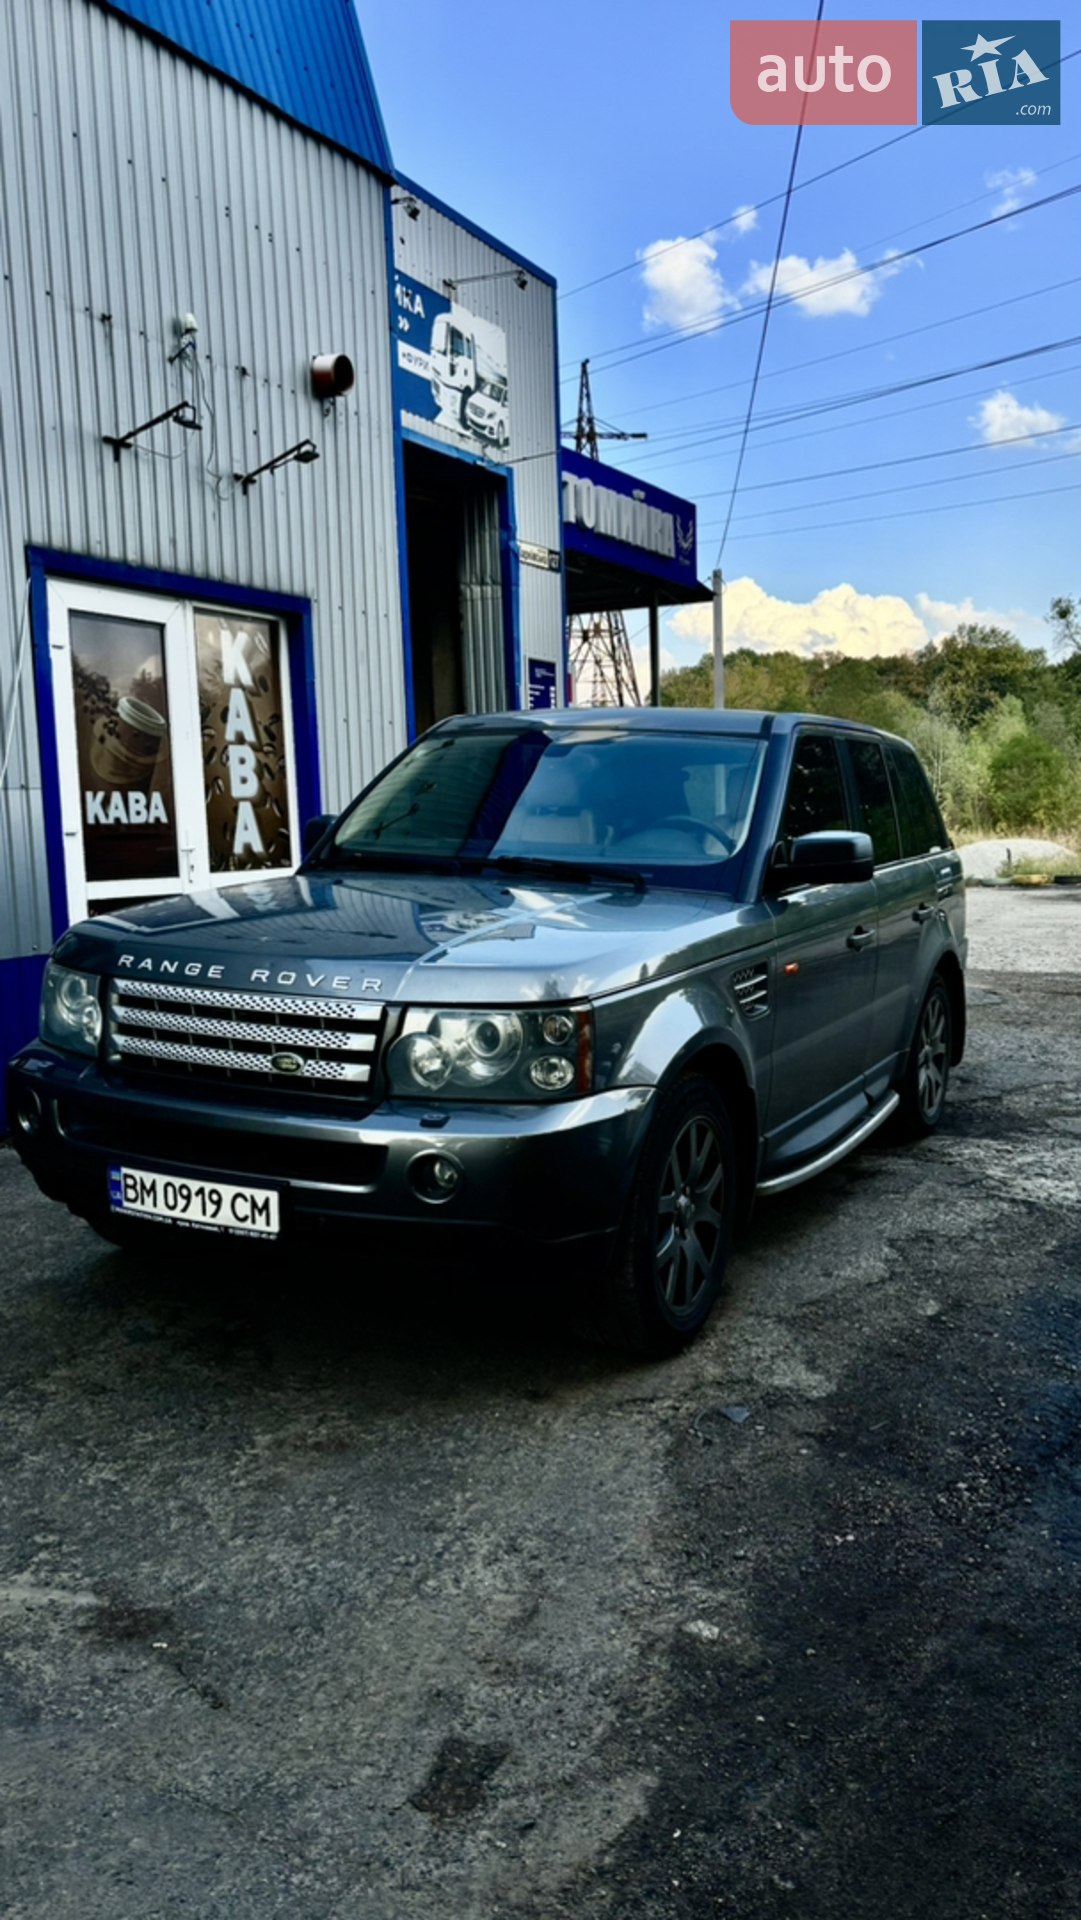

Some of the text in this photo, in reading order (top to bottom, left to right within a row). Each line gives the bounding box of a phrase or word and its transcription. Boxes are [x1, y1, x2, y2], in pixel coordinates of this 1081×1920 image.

[220, 628, 266, 855] КАВА
[84, 790, 168, 825] КАВА
[117, 954, 383, 992] RANGE ROVER
[123, 1173, 158, 1208] BM
[163, 1181, 223, 1219] 0919
[231, 1192, 271, 1228] CM
